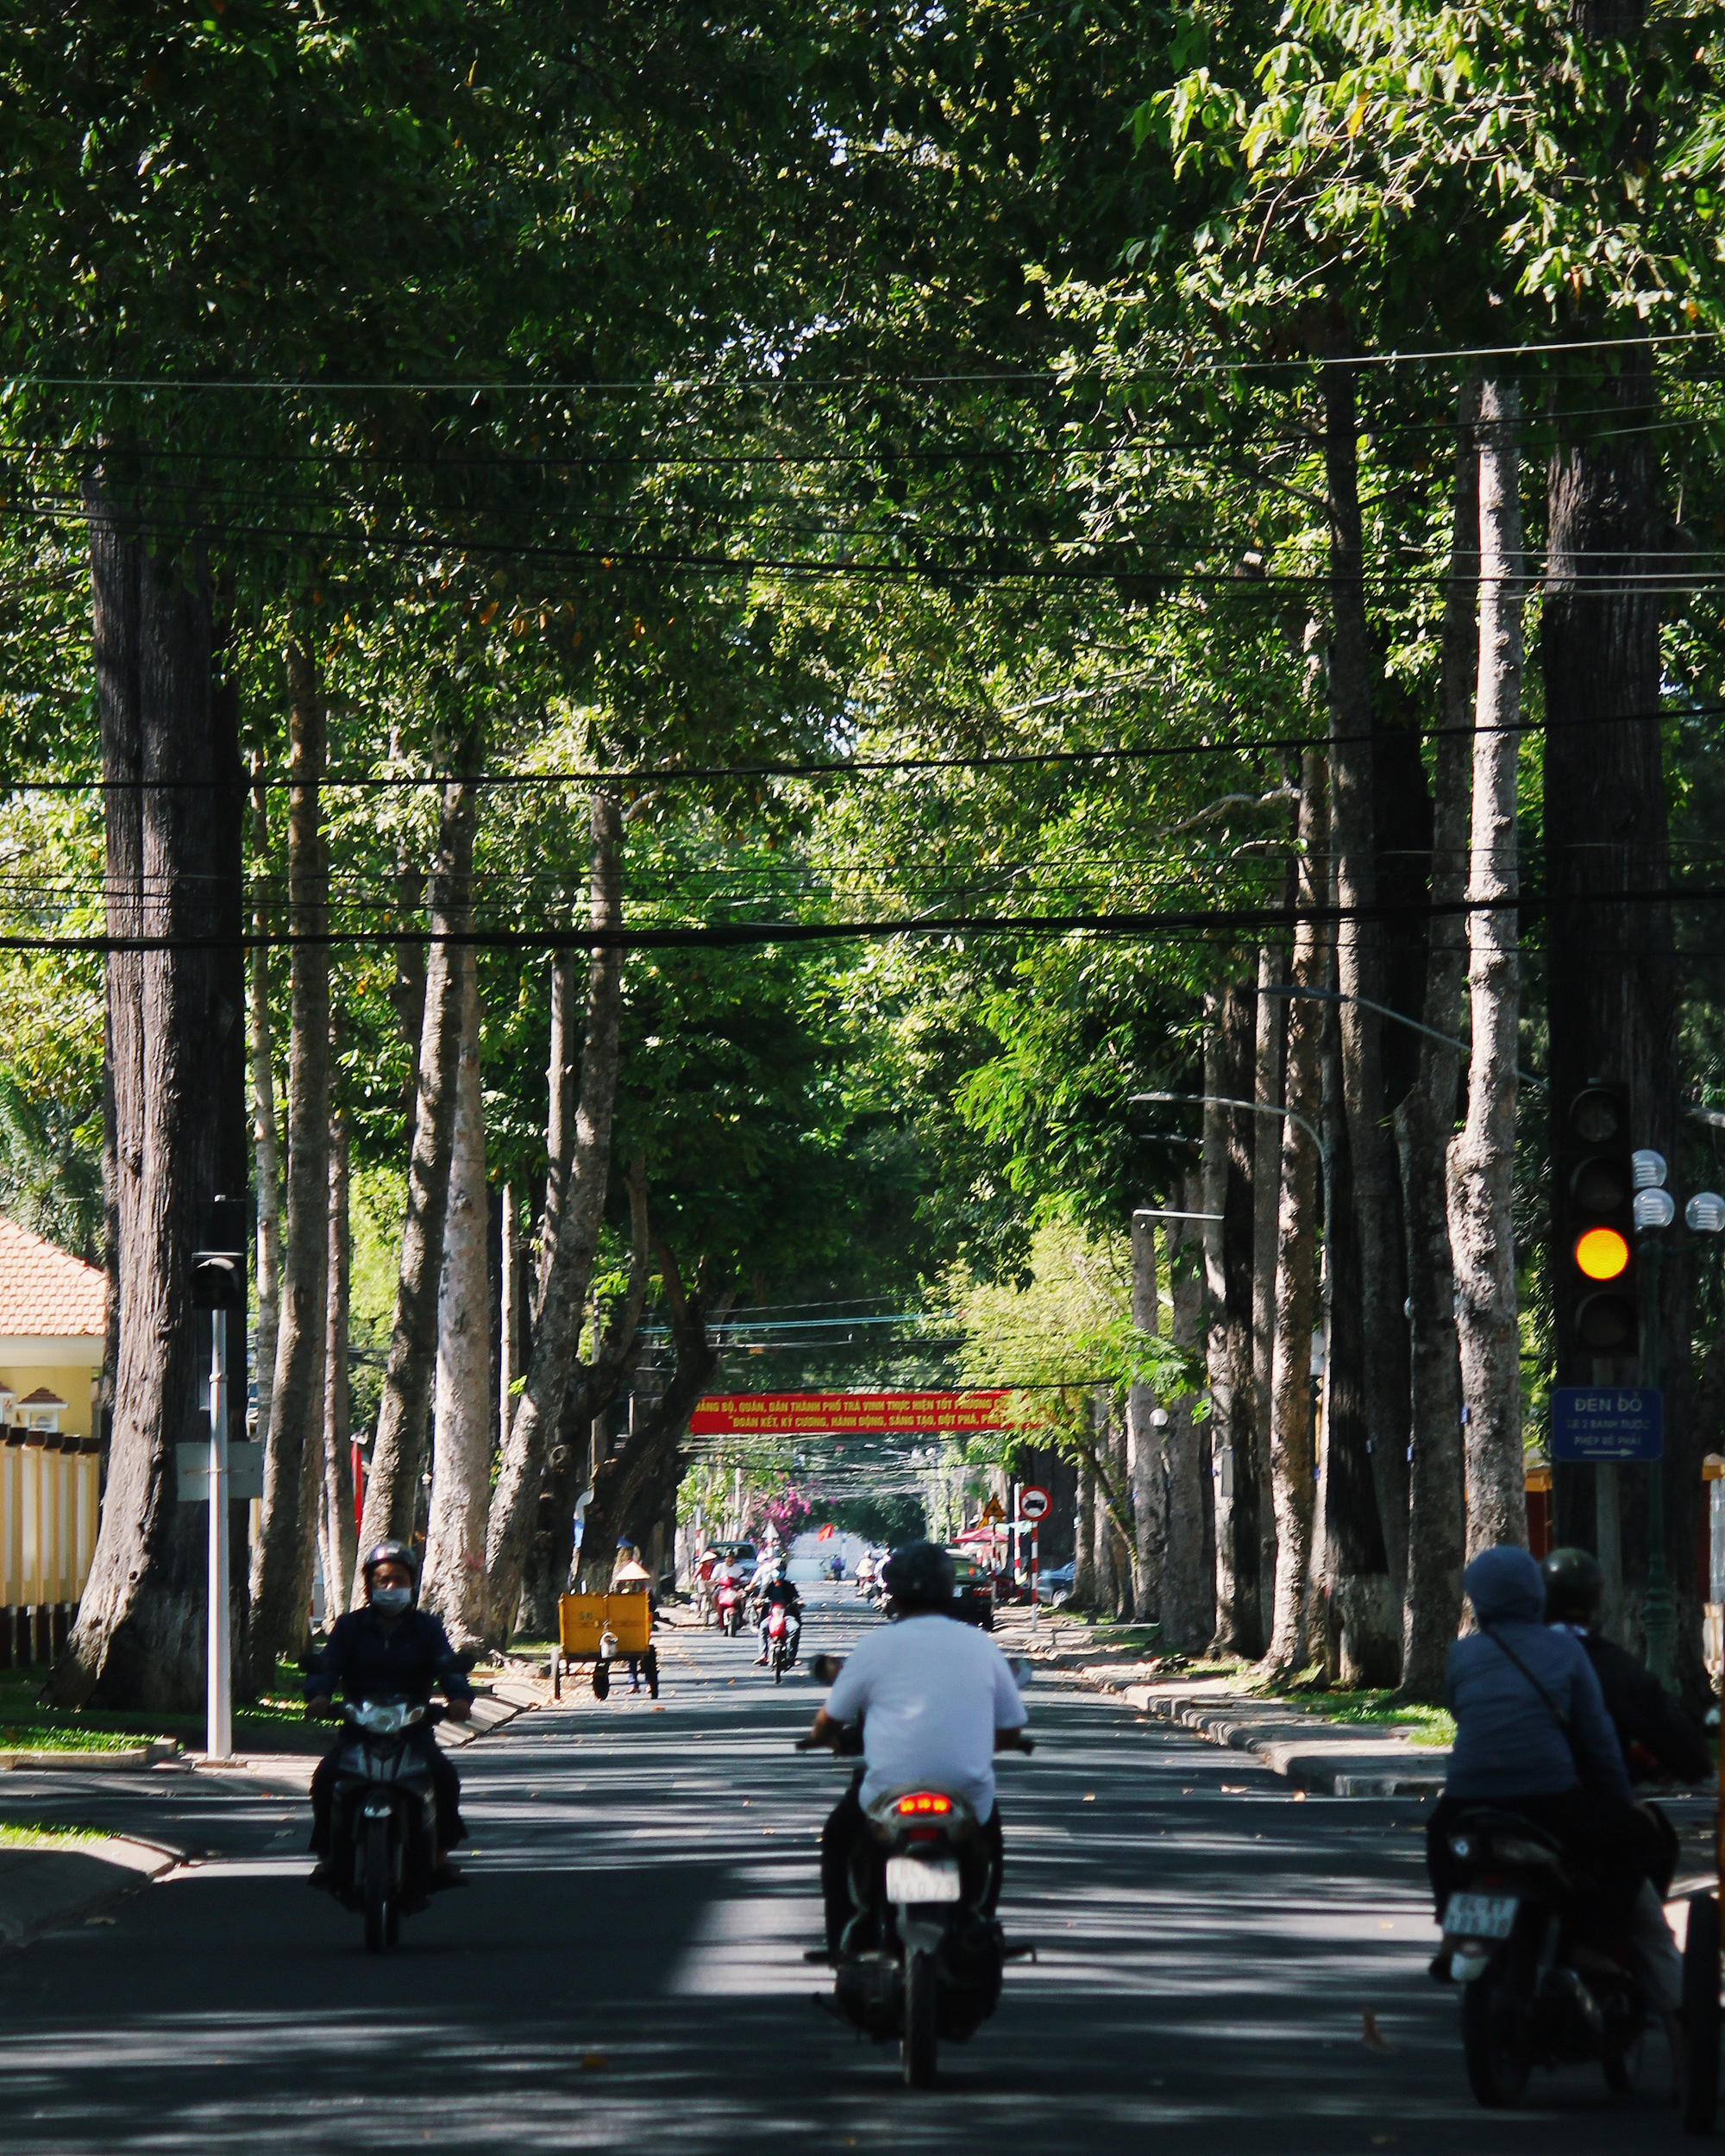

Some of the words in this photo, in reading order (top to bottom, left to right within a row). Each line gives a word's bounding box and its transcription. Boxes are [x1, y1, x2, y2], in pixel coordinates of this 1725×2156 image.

[791, 1400, 820, 1412] THÀNH
[822, 1399, 841, 1412] PHỐ
[843, 1400, 861, 1411] TRÀ
[862, 1401, 885, 1411] VINH
[886, 1400, 911, 1413] THỰC
[912, 1398, 934, 1413] HIỆN
[936, 1397, 952, 1410] TỐT
[1574, 1392, 1611, 1412] ĐÈN
[1617, 1391, 1643, 1413] ĐỎ
[831, 1414, 856, 1426] HÀNH
[888, 1414, 914, 1426] SÁNG
